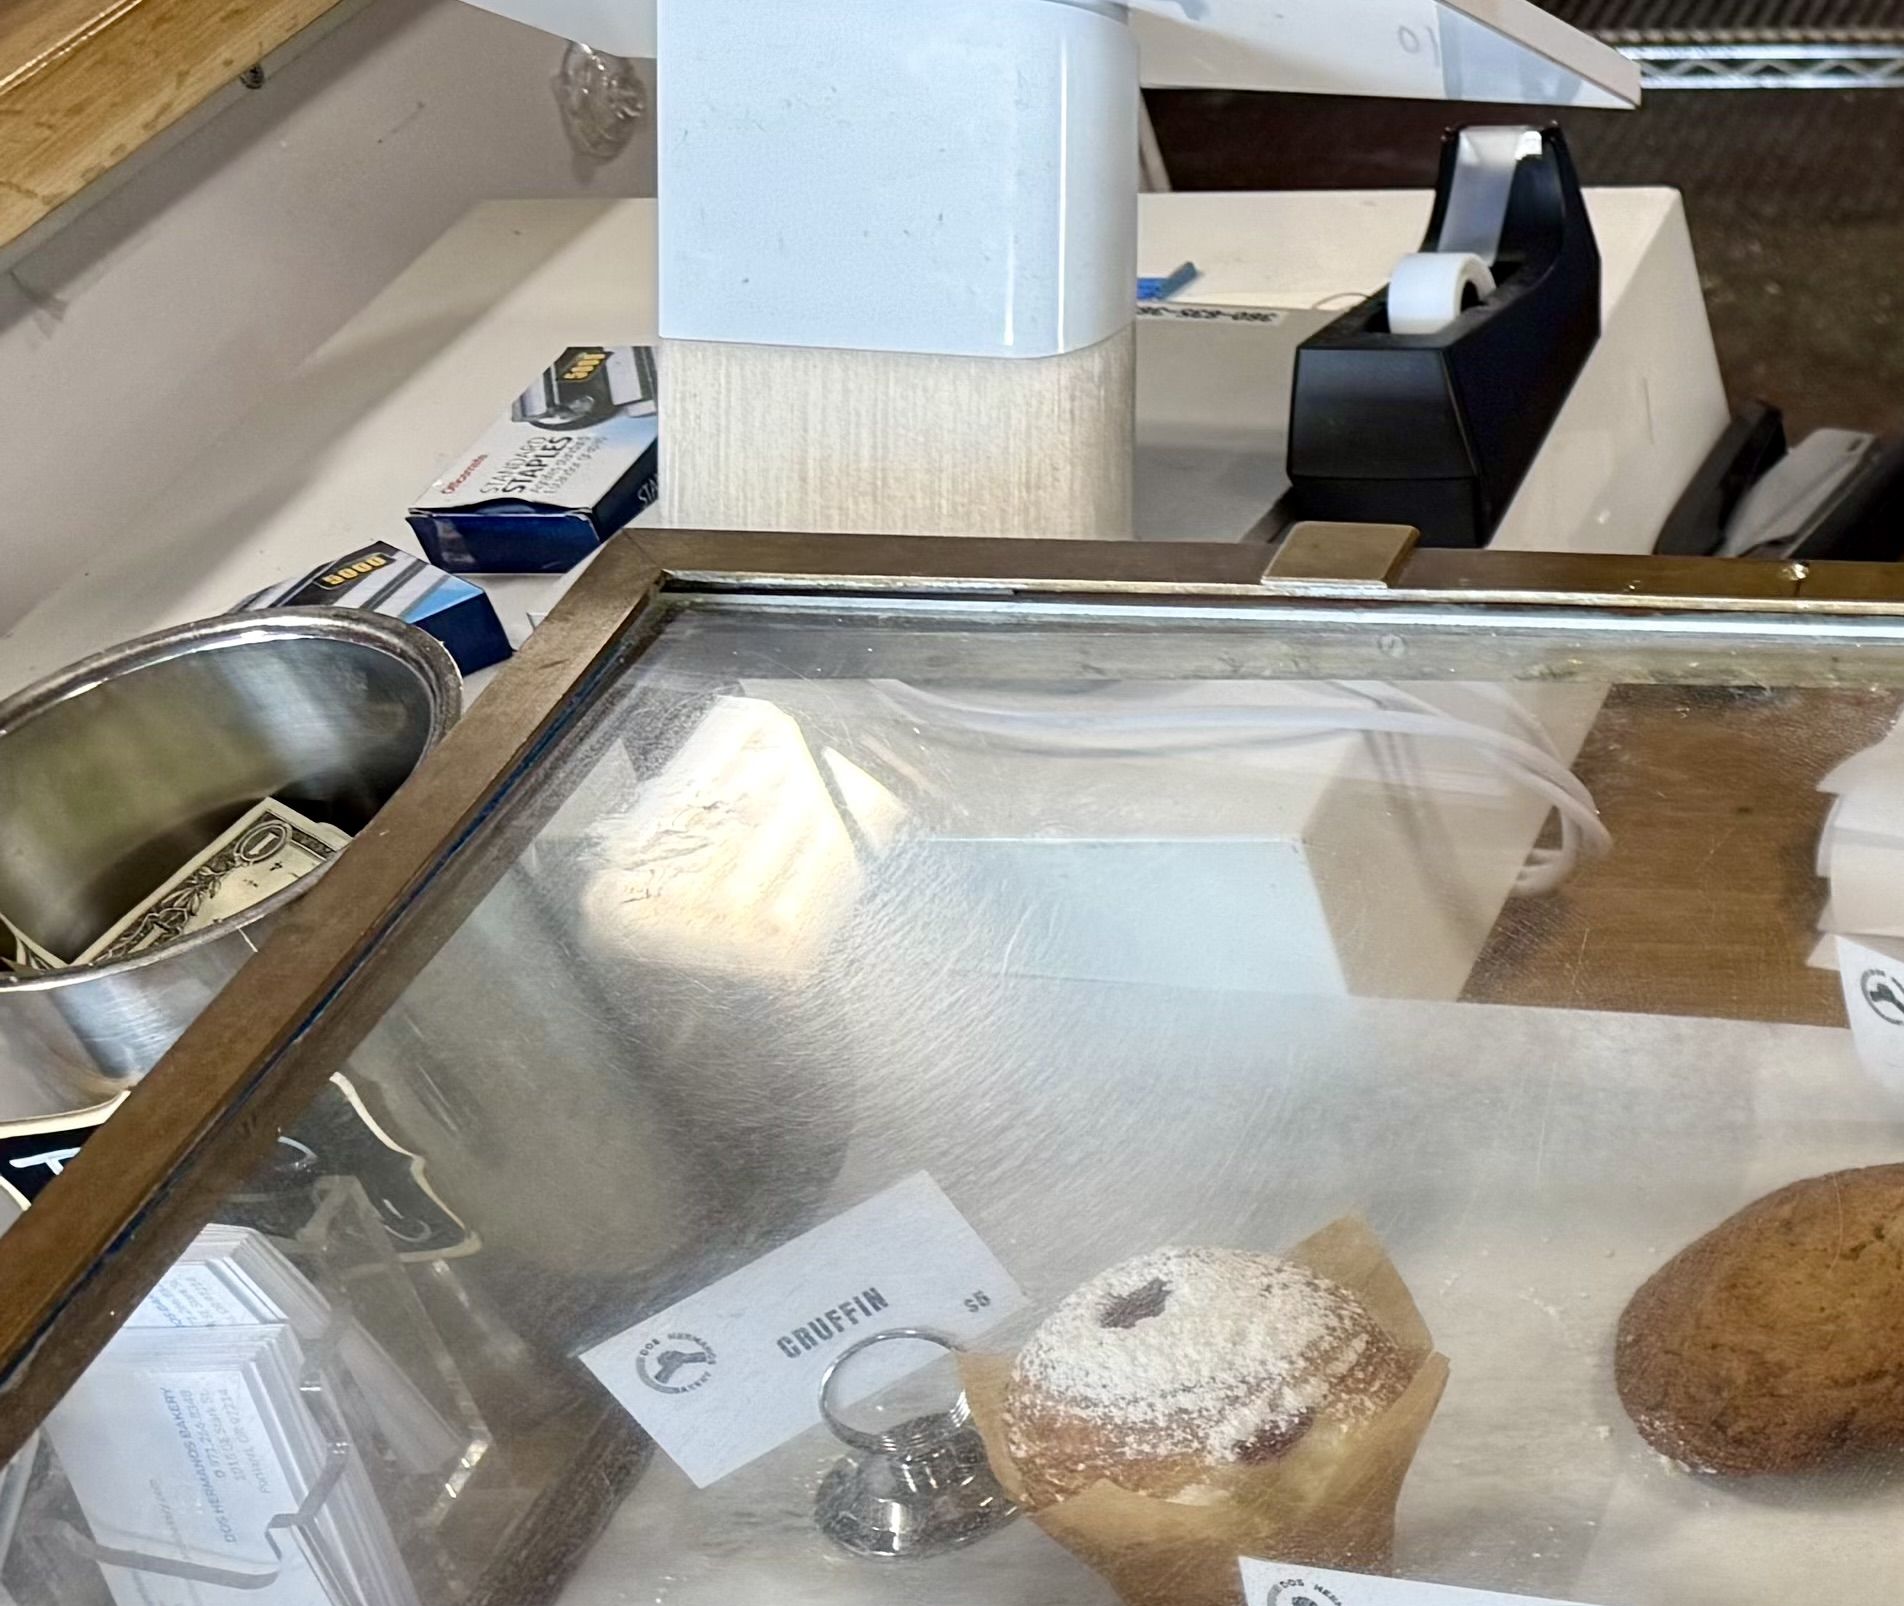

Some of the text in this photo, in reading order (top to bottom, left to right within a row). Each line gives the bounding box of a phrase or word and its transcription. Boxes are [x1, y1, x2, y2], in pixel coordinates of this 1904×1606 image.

[480, 436, 546, 494] STANDARD
[502, 436, 573, 494] STAPLES
[322, 555, 388, 586] 5000
[775, 1287, 889, 1360] CRUFFIN
[963, 1290, 991, 1314] $5
